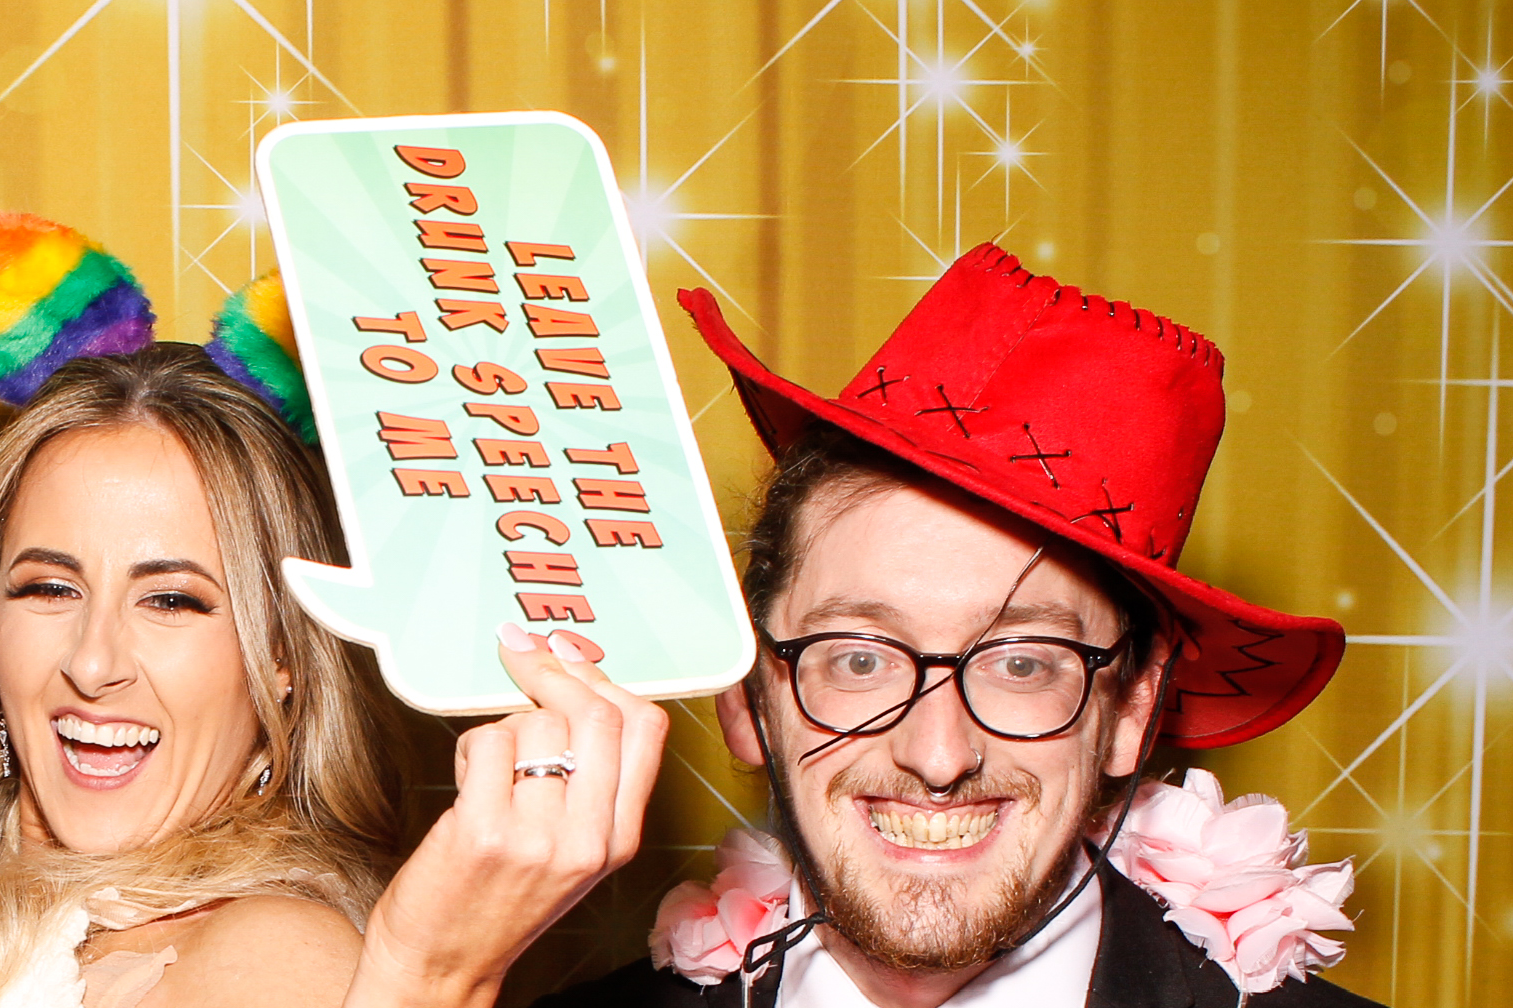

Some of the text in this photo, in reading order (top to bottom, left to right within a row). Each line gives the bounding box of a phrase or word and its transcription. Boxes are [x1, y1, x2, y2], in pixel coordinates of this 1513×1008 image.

[394, 144, 510, 334] DRUNK
[352, 310, 471, 498] TO ME
[505, 240, 664, 549] LEAVE THE
